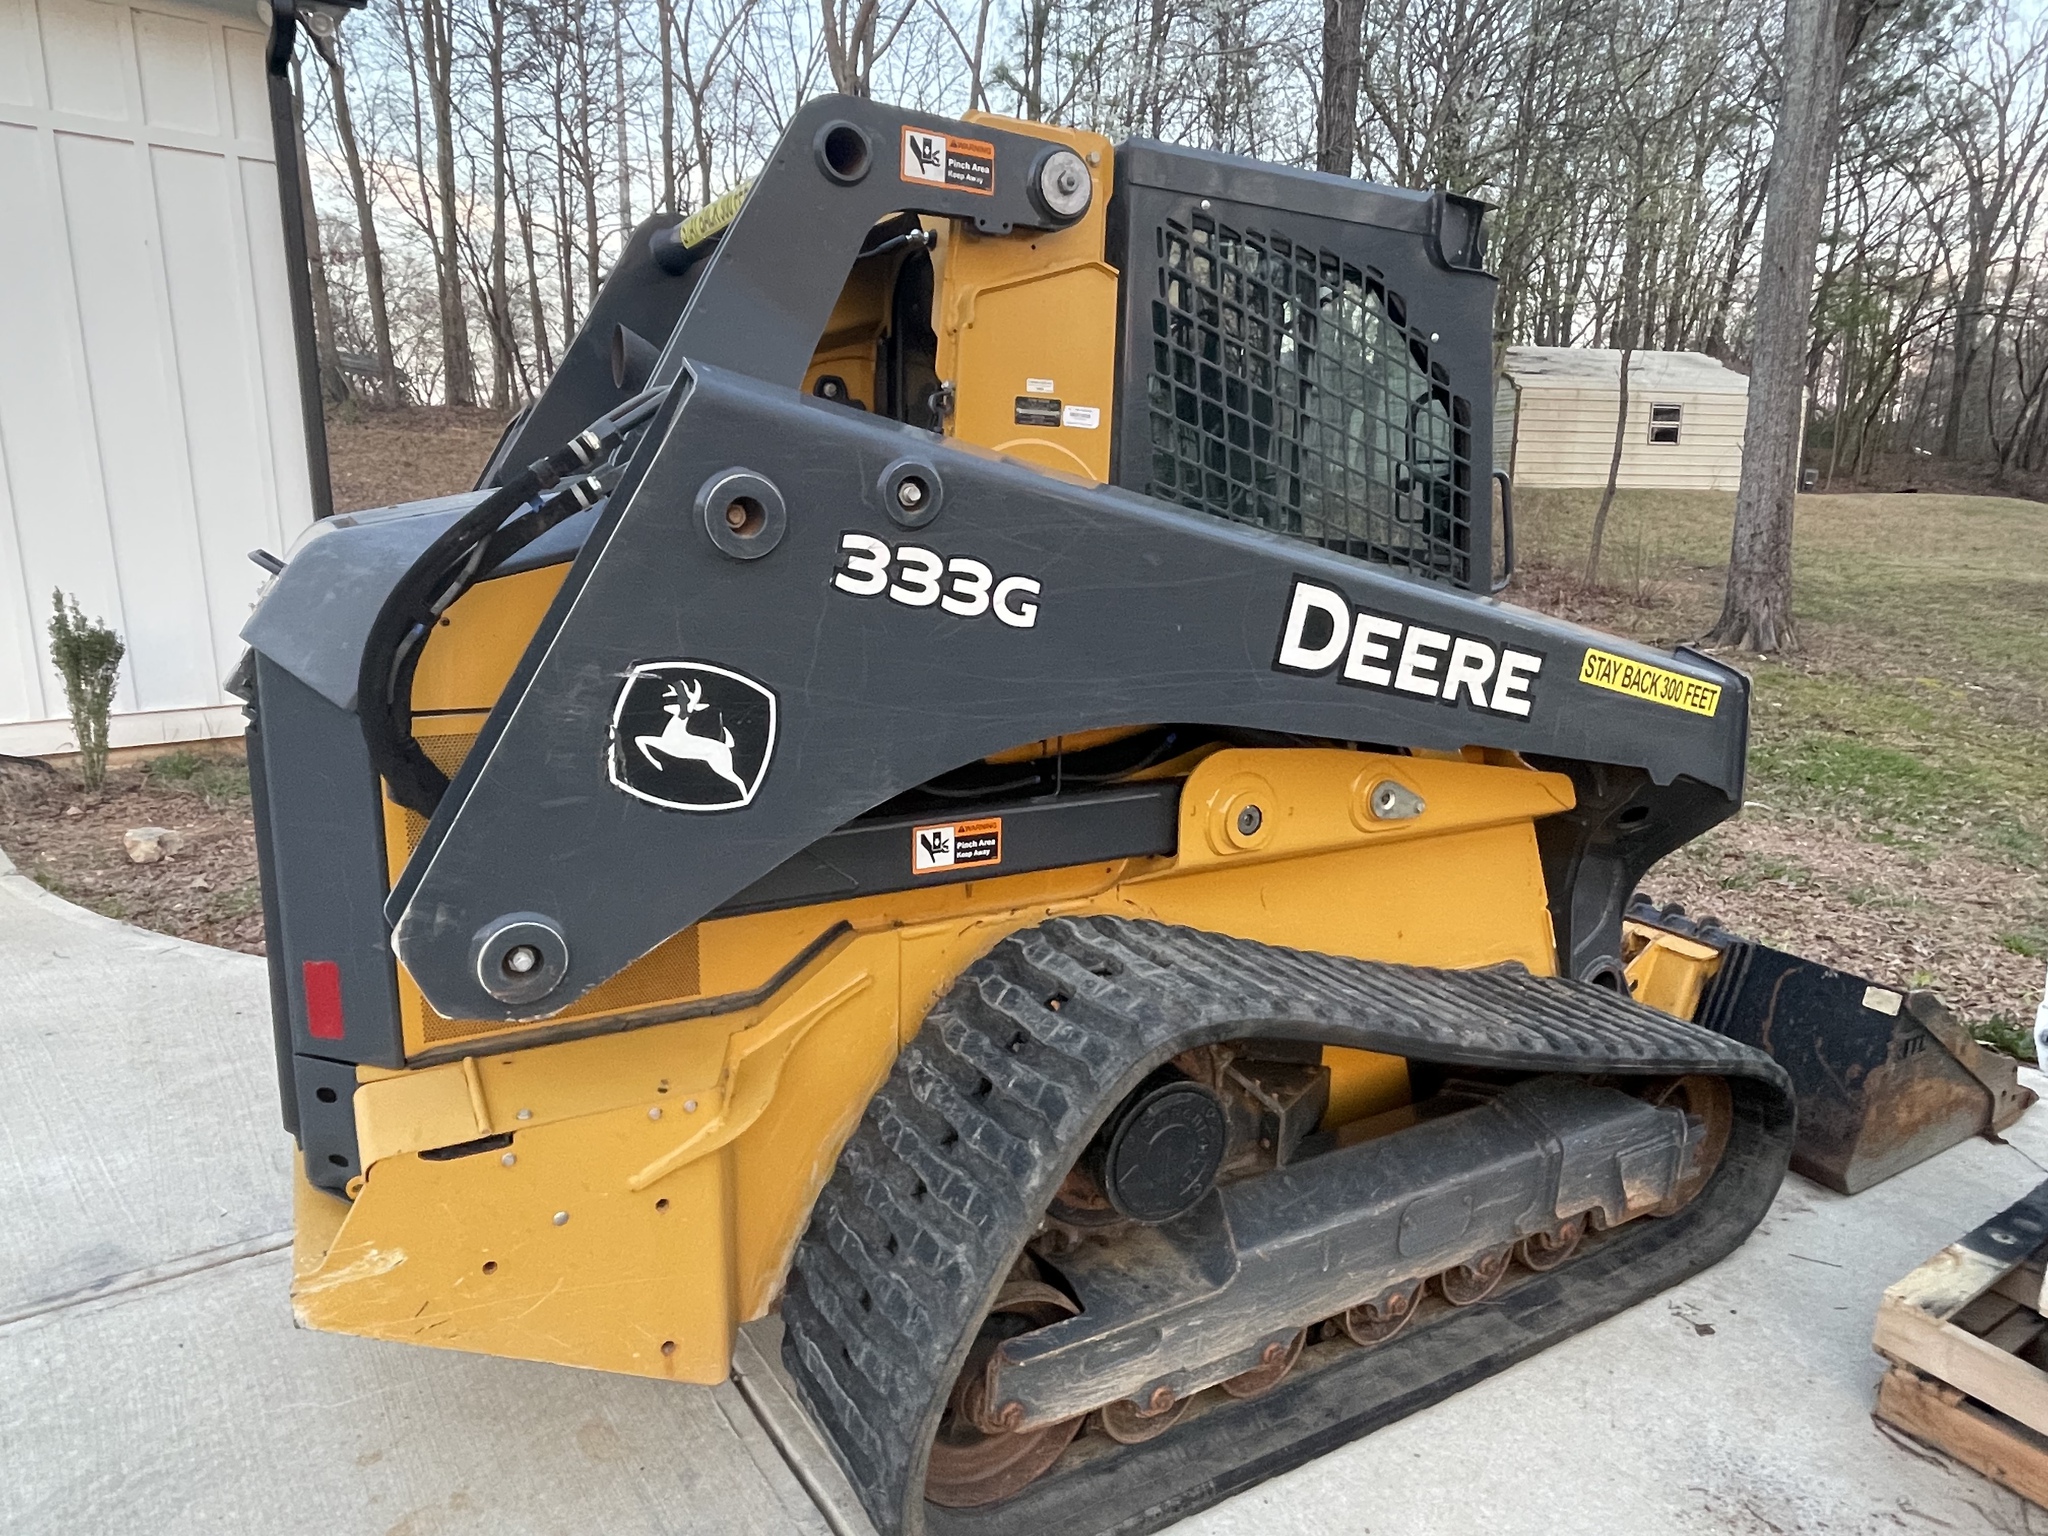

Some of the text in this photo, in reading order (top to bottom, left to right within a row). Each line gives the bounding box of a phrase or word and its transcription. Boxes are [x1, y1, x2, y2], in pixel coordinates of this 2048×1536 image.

[948, 158, 990, 174] Pinch Area
[947, 170, 984, 184] Keep Away
[834, 533, 1041, 628] 333G
[1278, 581, 1542, 716] DEERE
[1584, 654, 1717, 711] STAY BACK 300 FEET
[964, 822, 997, 832] WARNING
[956, 838, 996, 849] Pinch Area
[973, 849, 990, 857] Away
